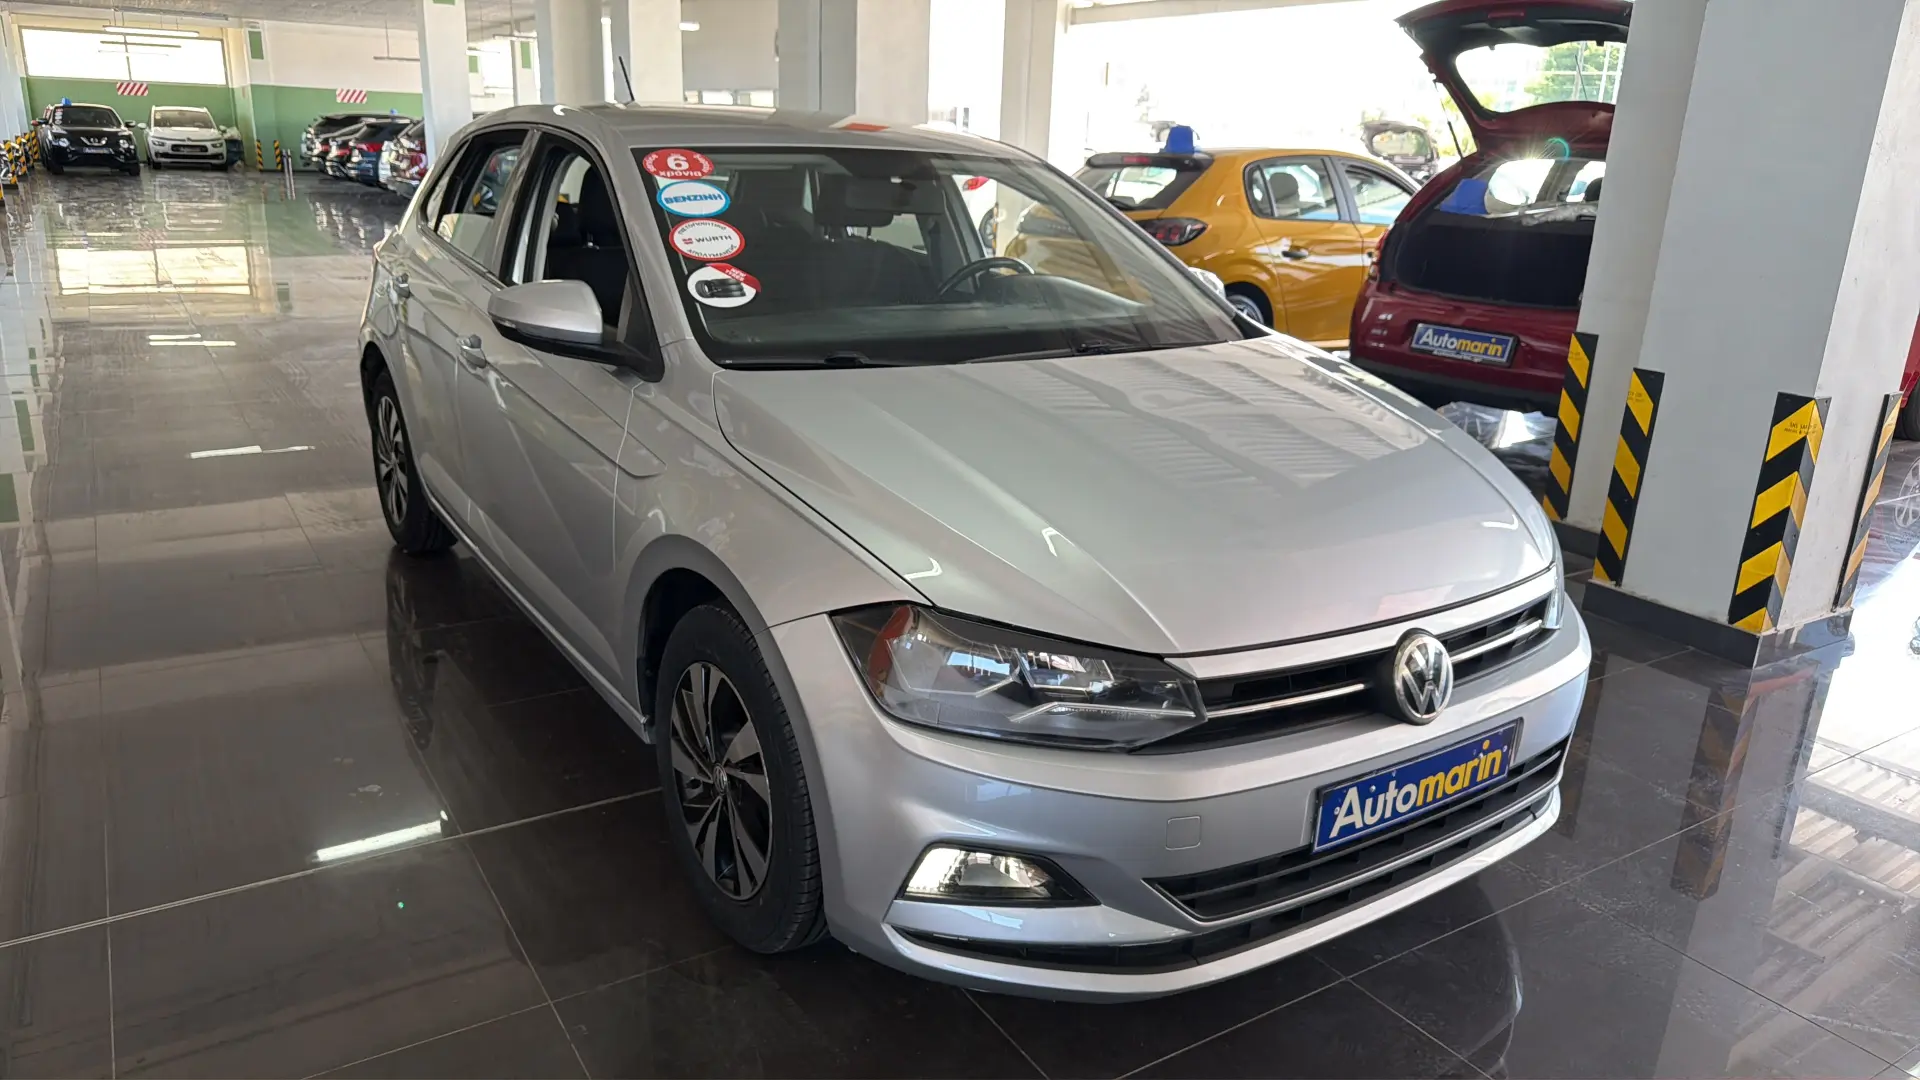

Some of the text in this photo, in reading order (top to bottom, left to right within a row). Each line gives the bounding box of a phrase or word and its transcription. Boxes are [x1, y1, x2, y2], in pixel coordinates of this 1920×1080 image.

[667, 154, 689, 171] 6
[1419, 328, 1503, 357] Automarin
[1329, 739, 1502, 838] Automarin
